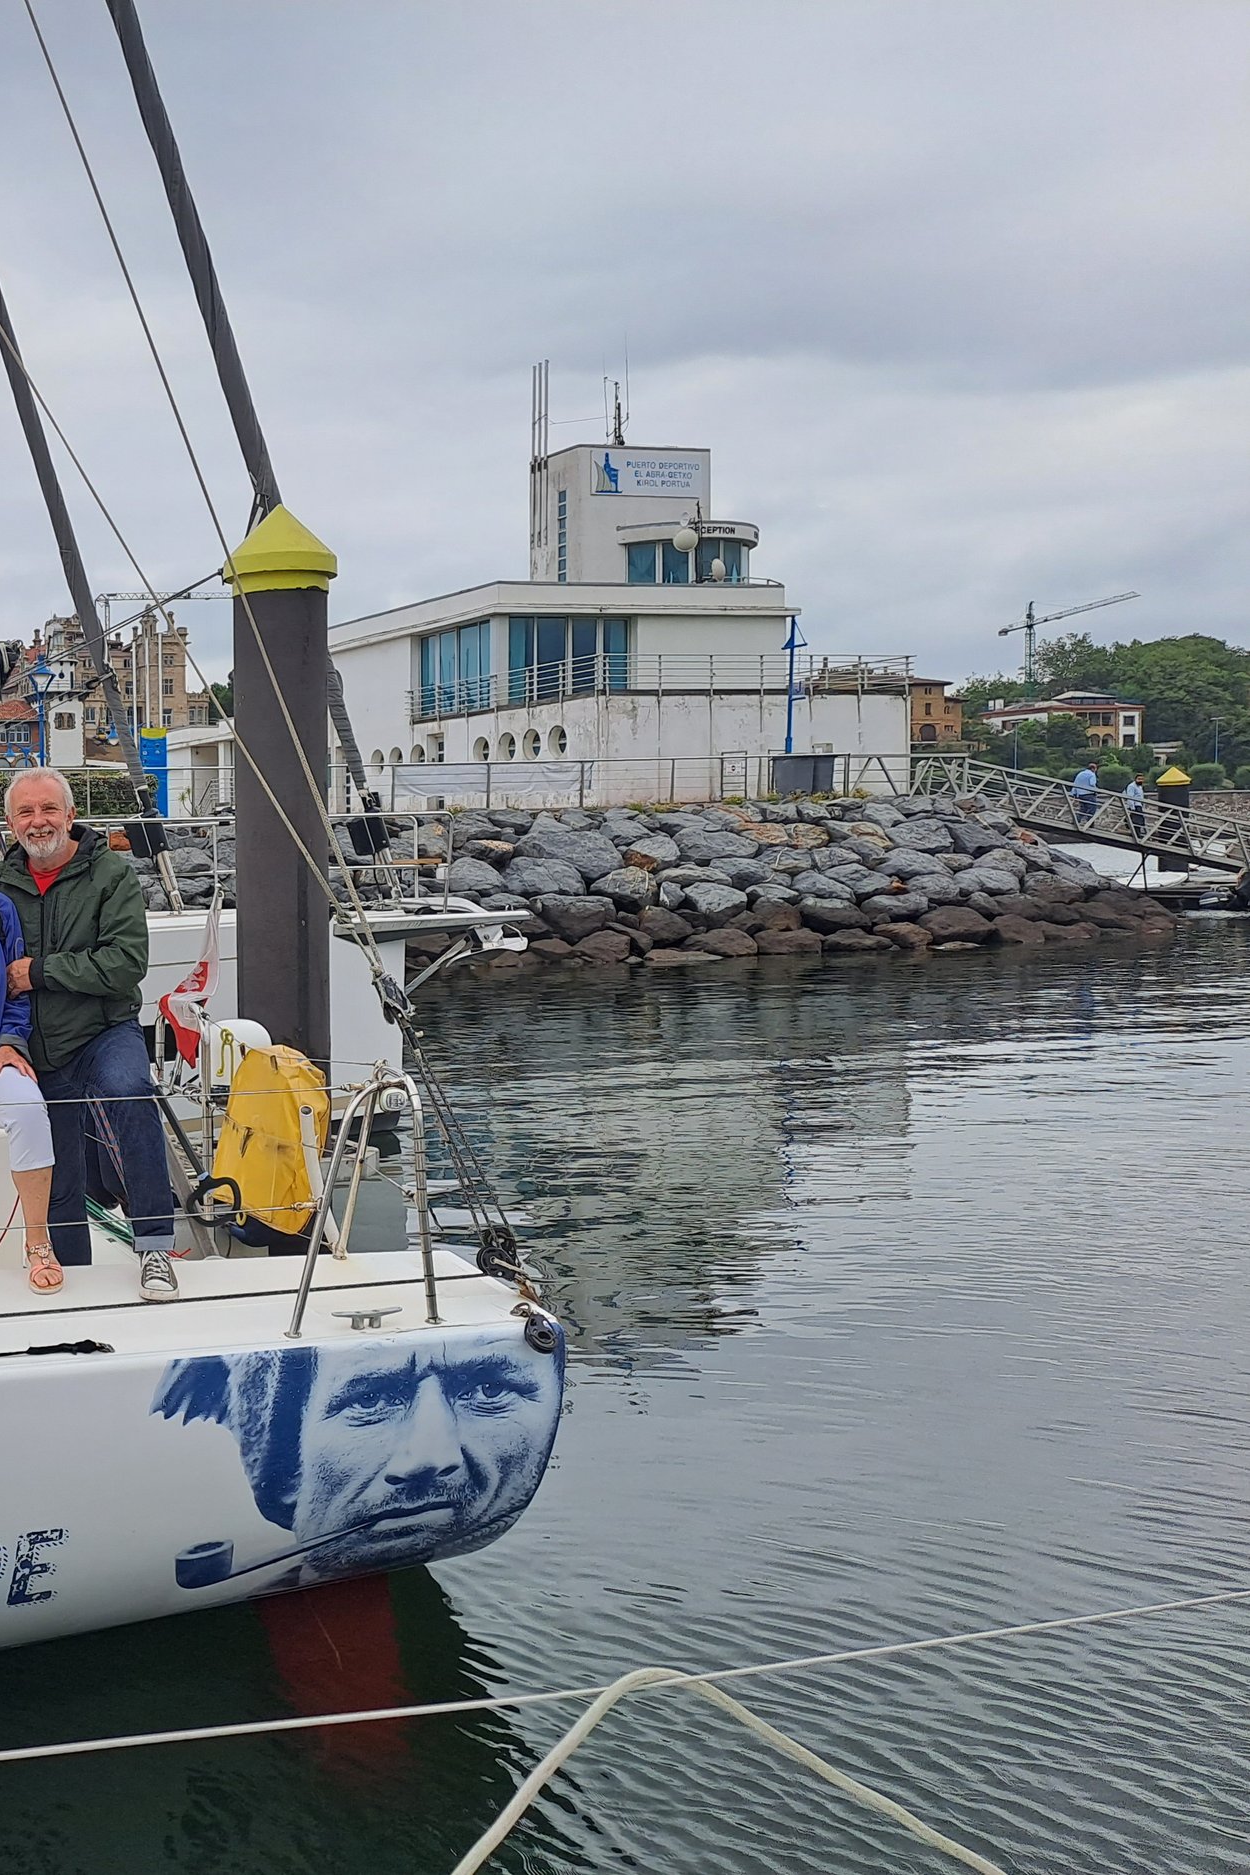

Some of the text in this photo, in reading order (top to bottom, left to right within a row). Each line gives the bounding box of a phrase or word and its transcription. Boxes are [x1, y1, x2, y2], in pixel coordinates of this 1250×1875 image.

[626, 461, 700, 471] PUERTO DEPORTIVO
[634, 470, 693, 479] EL ABRA-GETXO
[636, 479, 691, 488] KIROL PORTUA
